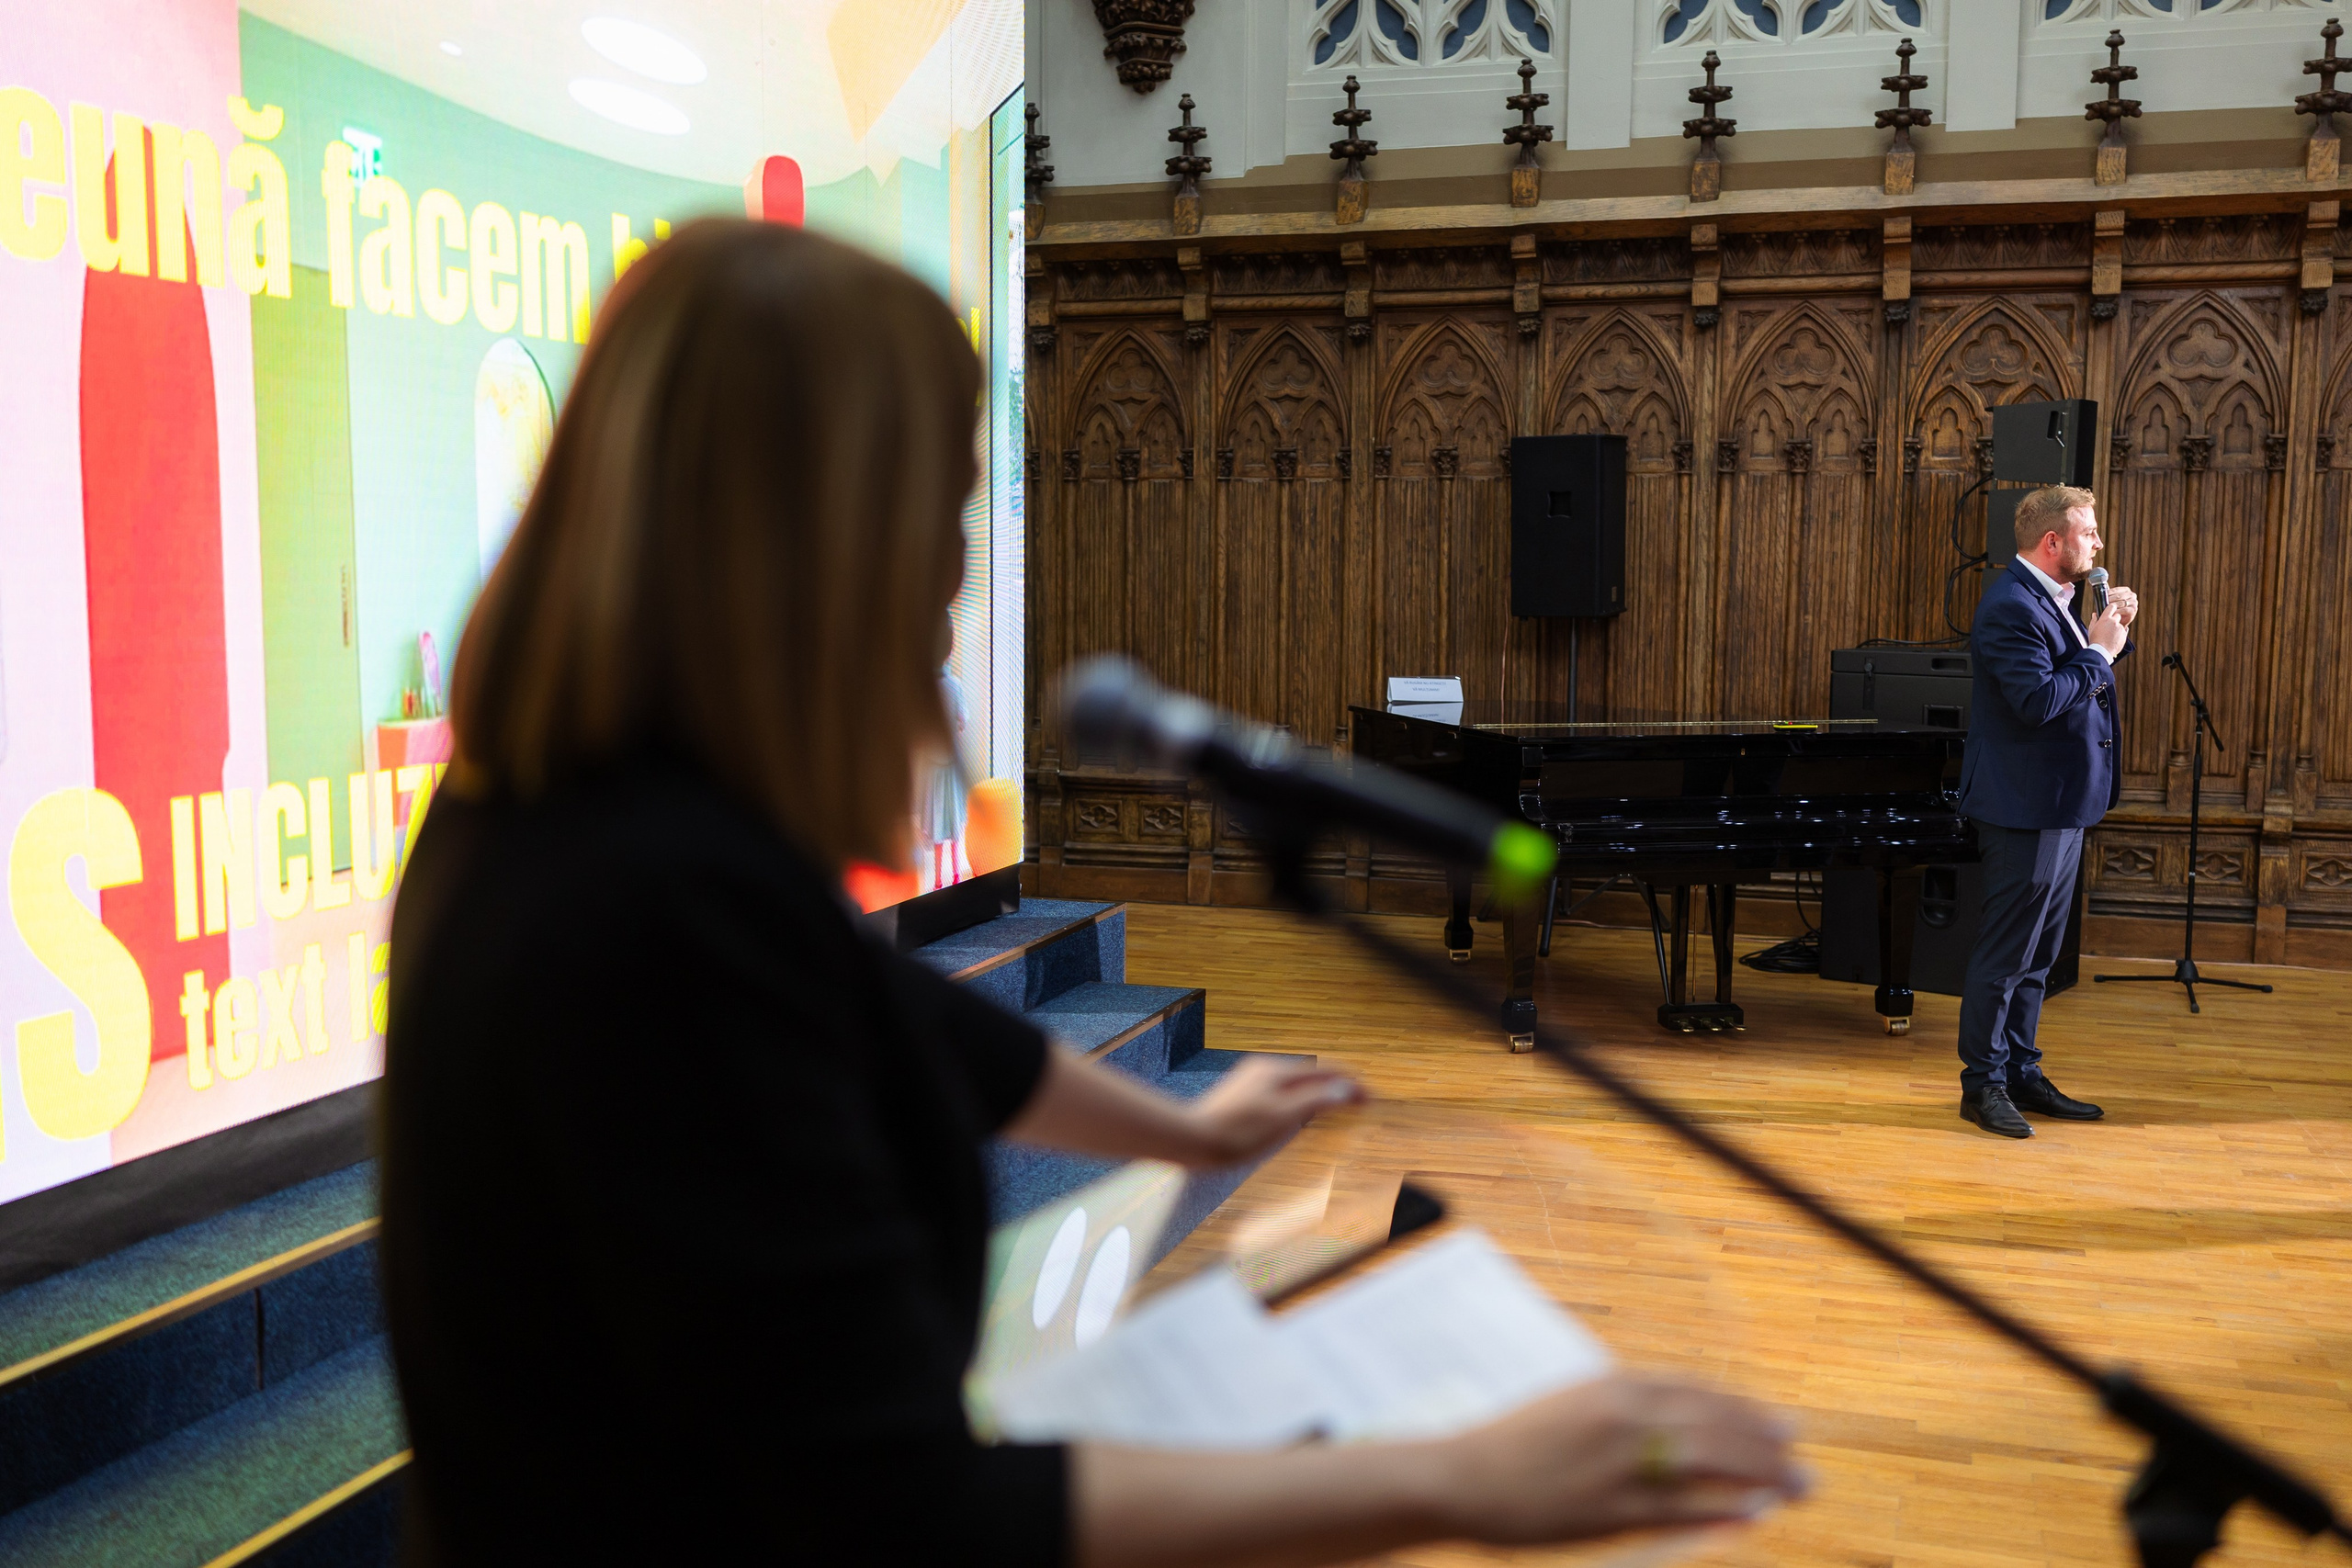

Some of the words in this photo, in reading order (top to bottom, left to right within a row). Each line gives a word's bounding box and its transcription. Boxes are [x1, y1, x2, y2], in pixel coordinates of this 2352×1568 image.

[322, 140, 591, 344] facem
[170, 762, 448, 942] INCLUZ
[0, 786, 153, 1164] S
[180, 942, 330, 1091] text
